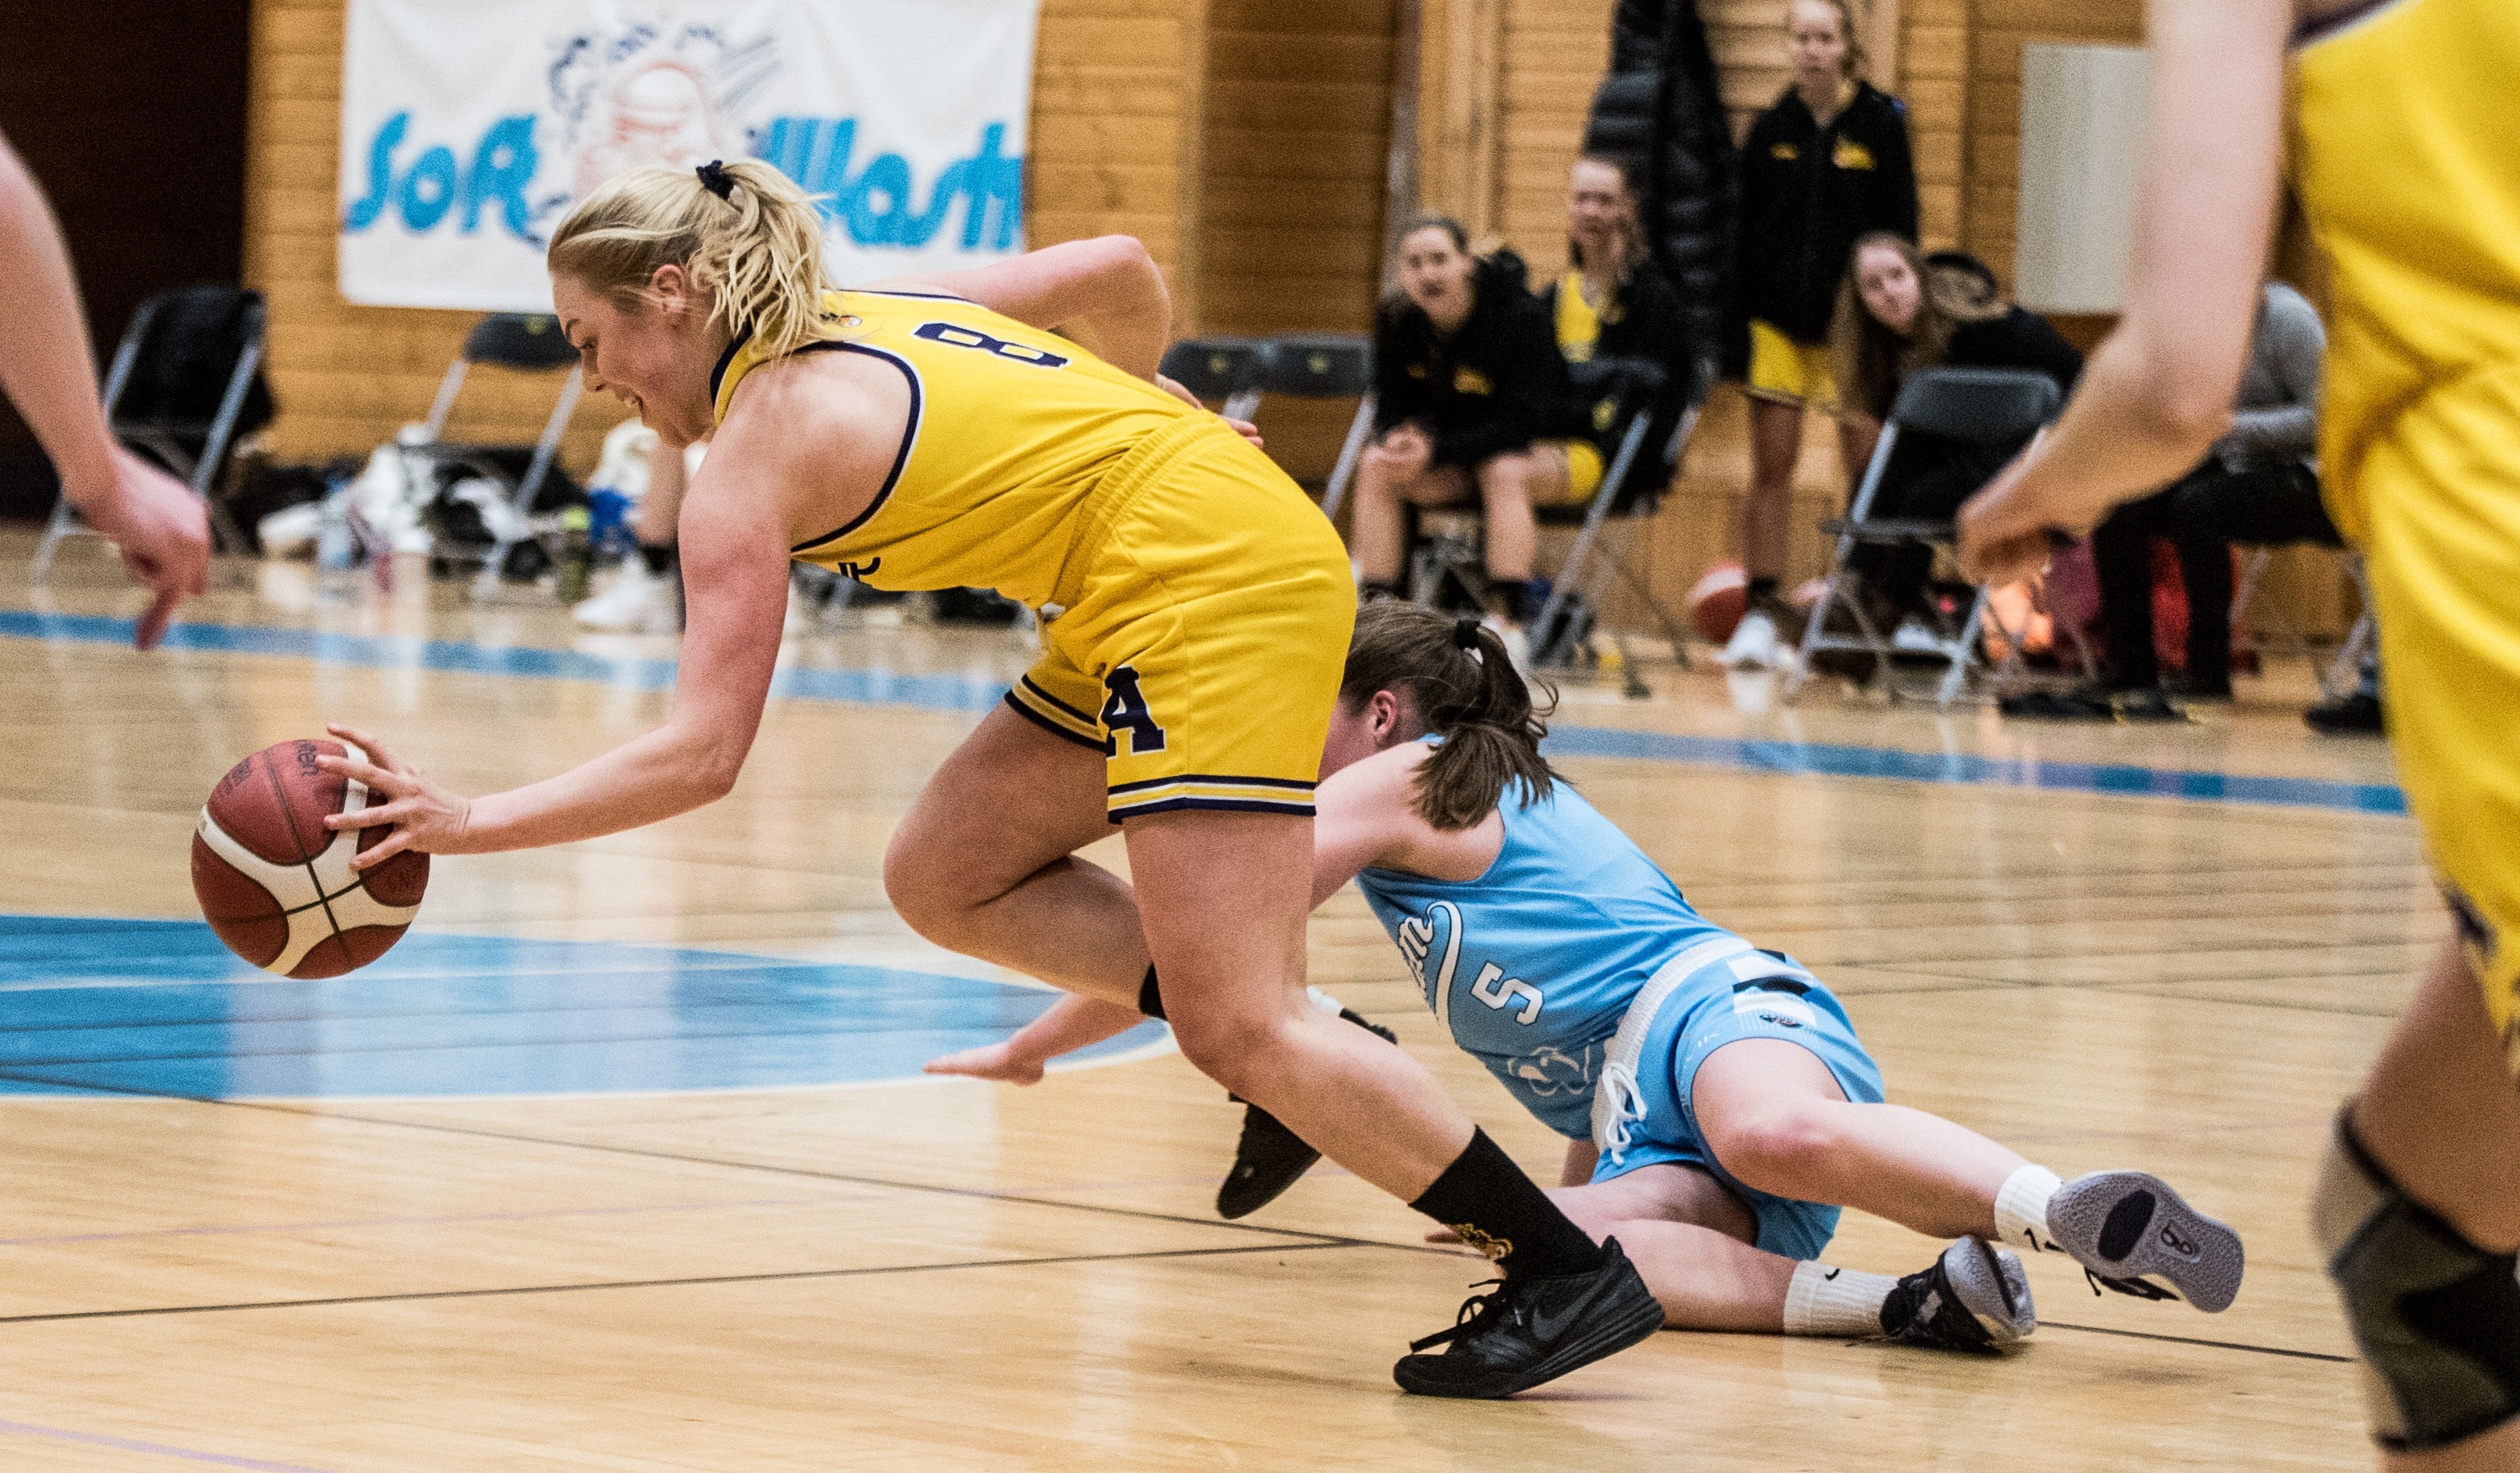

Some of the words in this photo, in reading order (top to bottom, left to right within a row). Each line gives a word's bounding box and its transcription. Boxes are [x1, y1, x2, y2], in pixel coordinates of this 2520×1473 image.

[911, 321, 1071, 370] 8
[1099, 664, 1167, 759] A
[1470, 959, 1545, 1026] 5
